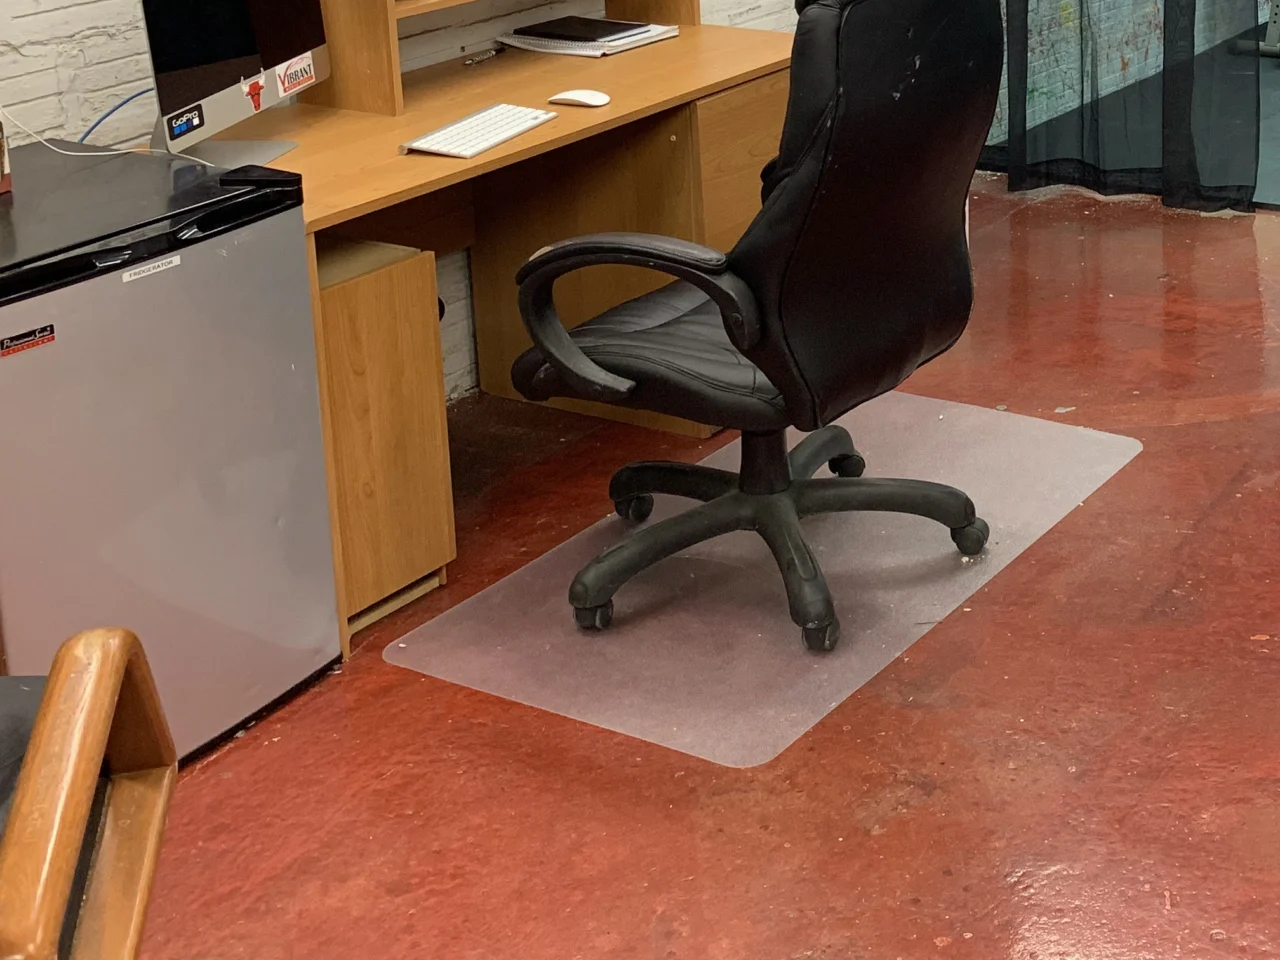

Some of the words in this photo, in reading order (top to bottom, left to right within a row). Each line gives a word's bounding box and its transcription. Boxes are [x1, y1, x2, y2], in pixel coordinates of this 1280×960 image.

[277, 59, 312, 89] VIBRANT
[172, 110, 199, 127] GoPro
[129, 259, 174, 278] FRIDGERATOR
